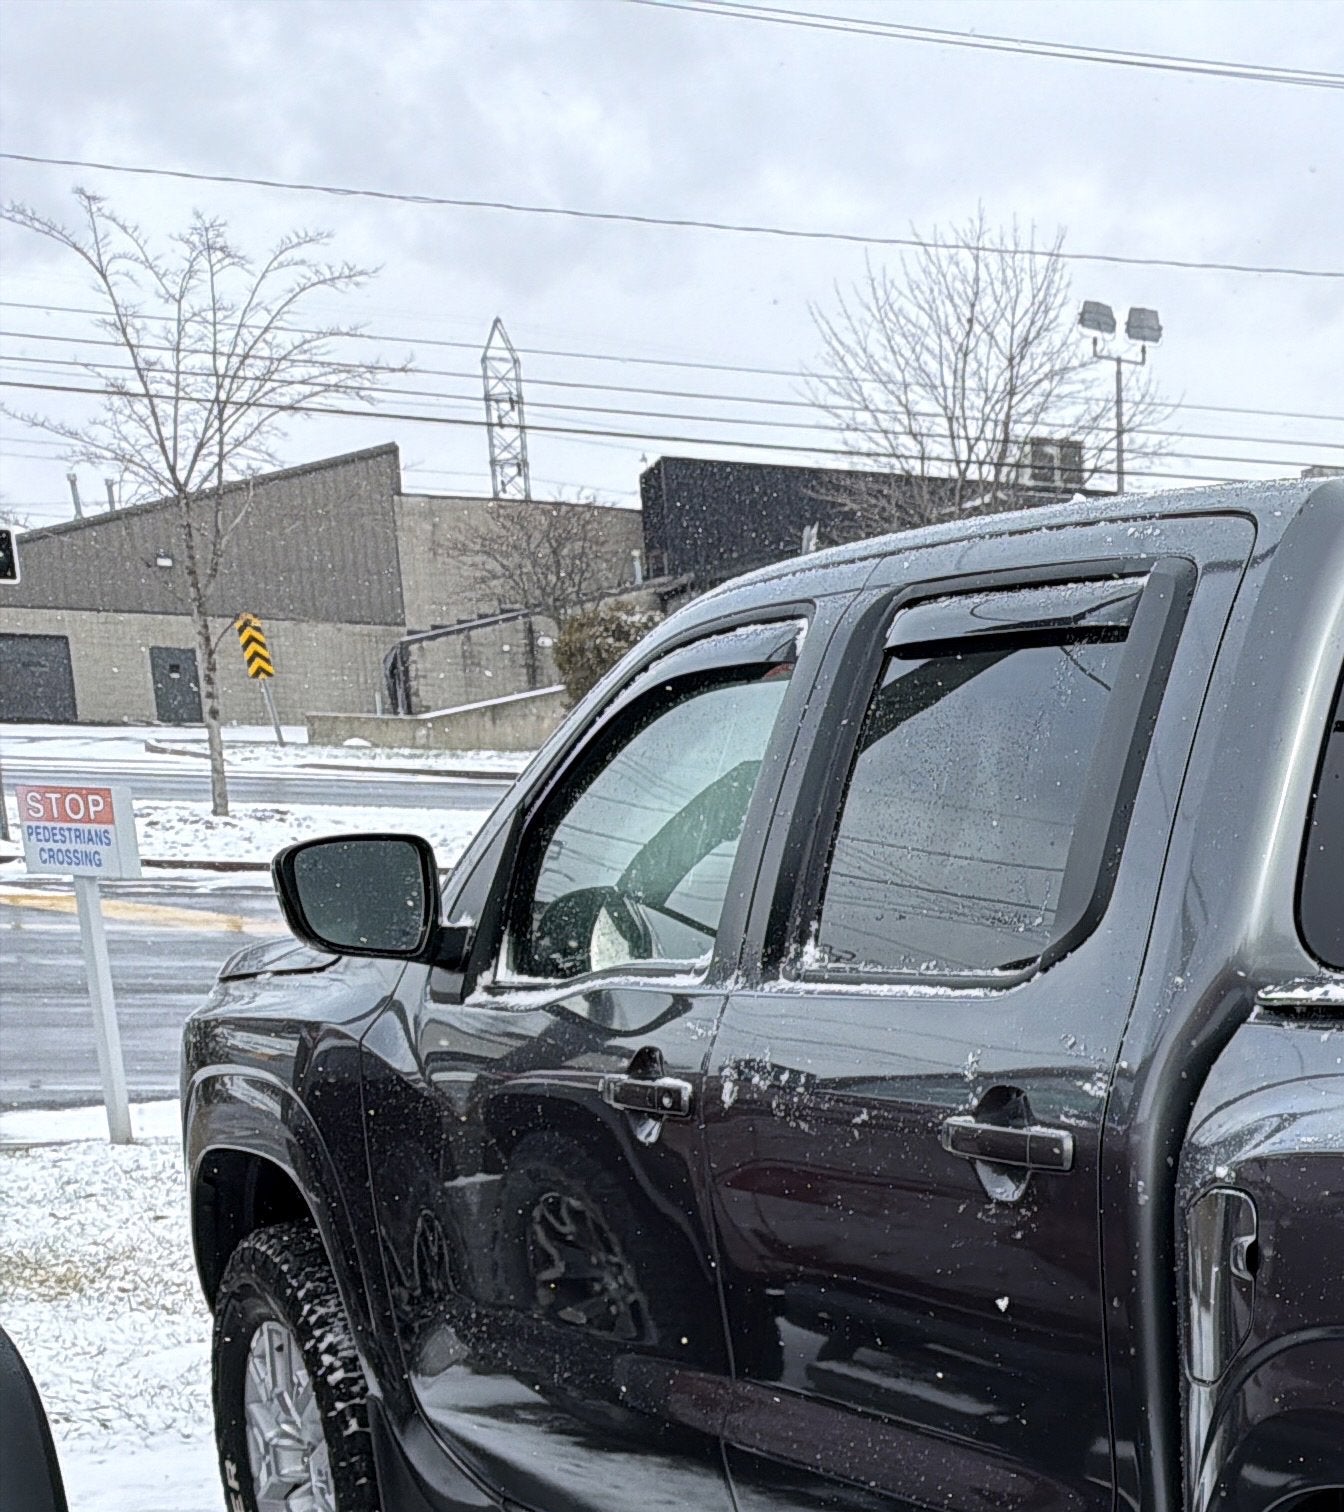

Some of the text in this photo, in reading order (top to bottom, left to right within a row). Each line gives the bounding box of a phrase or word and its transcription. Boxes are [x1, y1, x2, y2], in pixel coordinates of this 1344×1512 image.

[26, 791, 105, 820] STOP
[26, 825, 112, 846] PEDESTRIANS
[39, 847, 103, 867] CROSSING
